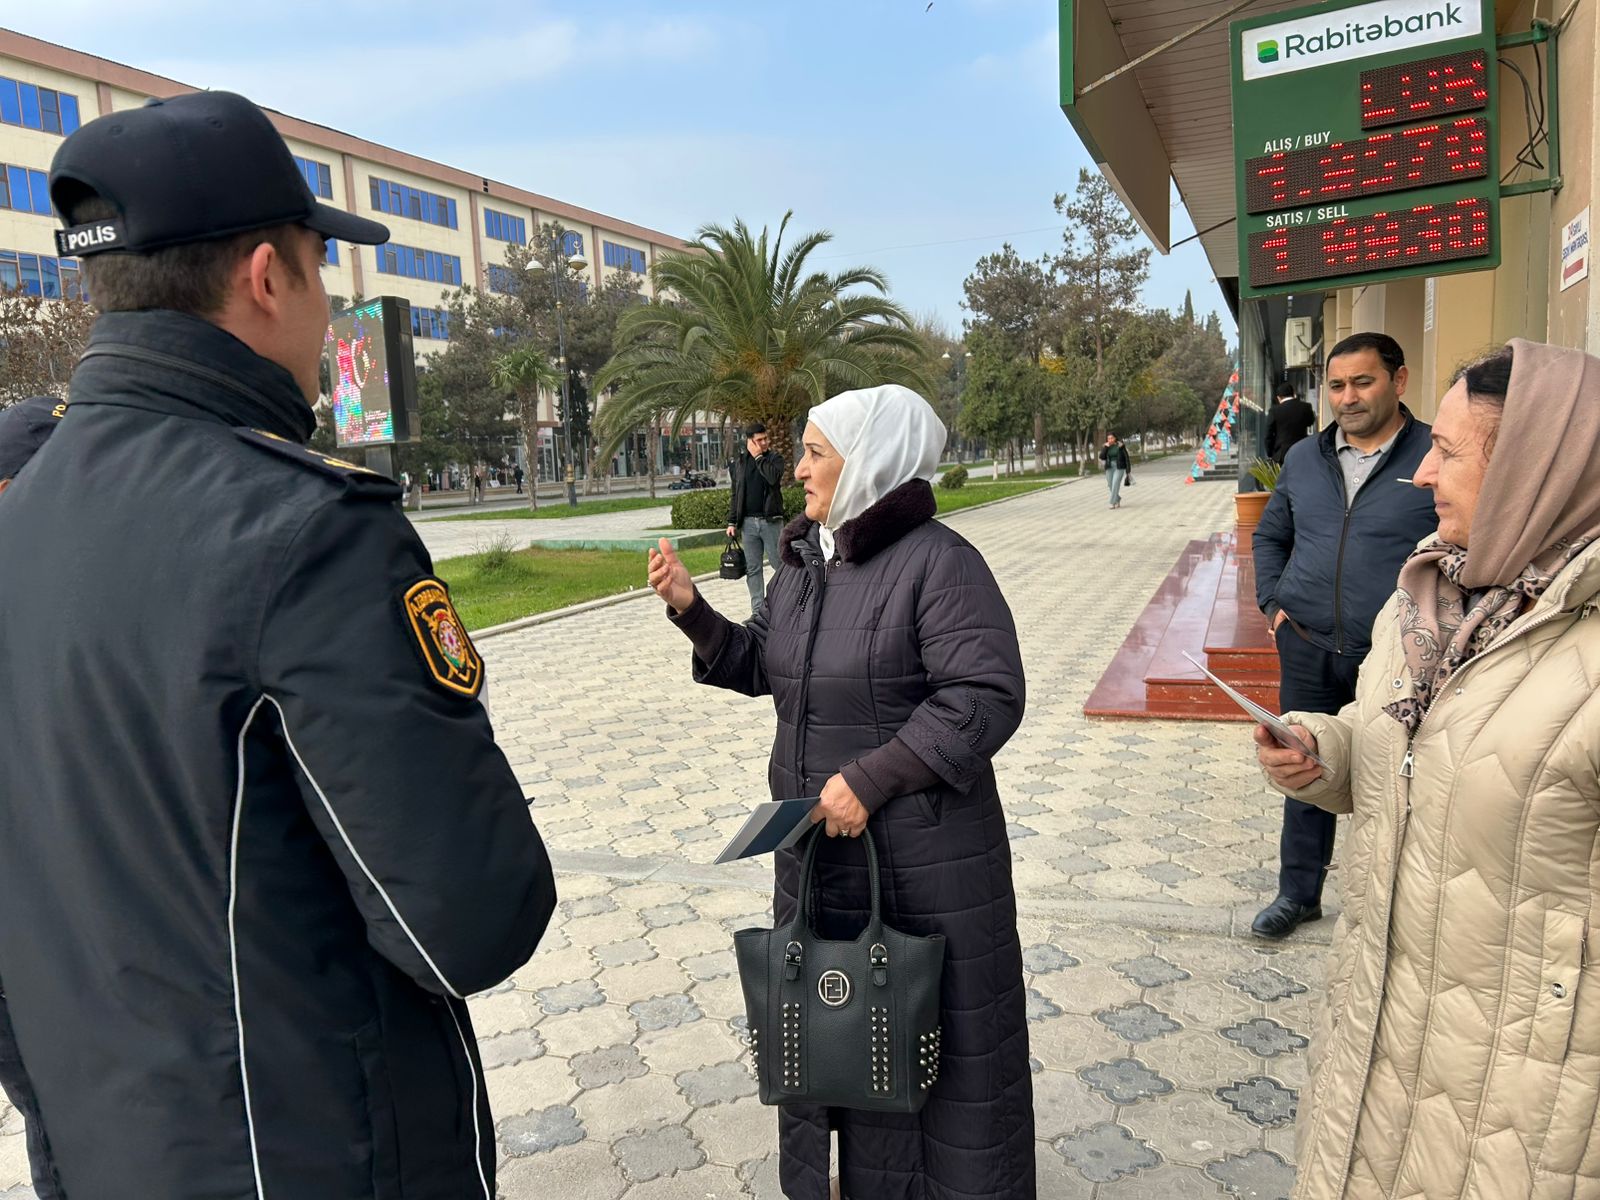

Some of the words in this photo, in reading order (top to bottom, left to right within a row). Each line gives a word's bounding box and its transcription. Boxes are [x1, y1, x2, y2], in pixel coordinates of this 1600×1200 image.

[1285, 2, 1462, 59] Rabitəbank
[1264, 137, 1292, 154] ALIŞ
[1304, 131, 1331, 147] BUY
[1266, 211, 1303, 228] SATIŞ
[1317, 205, 1349, 220] SELL
